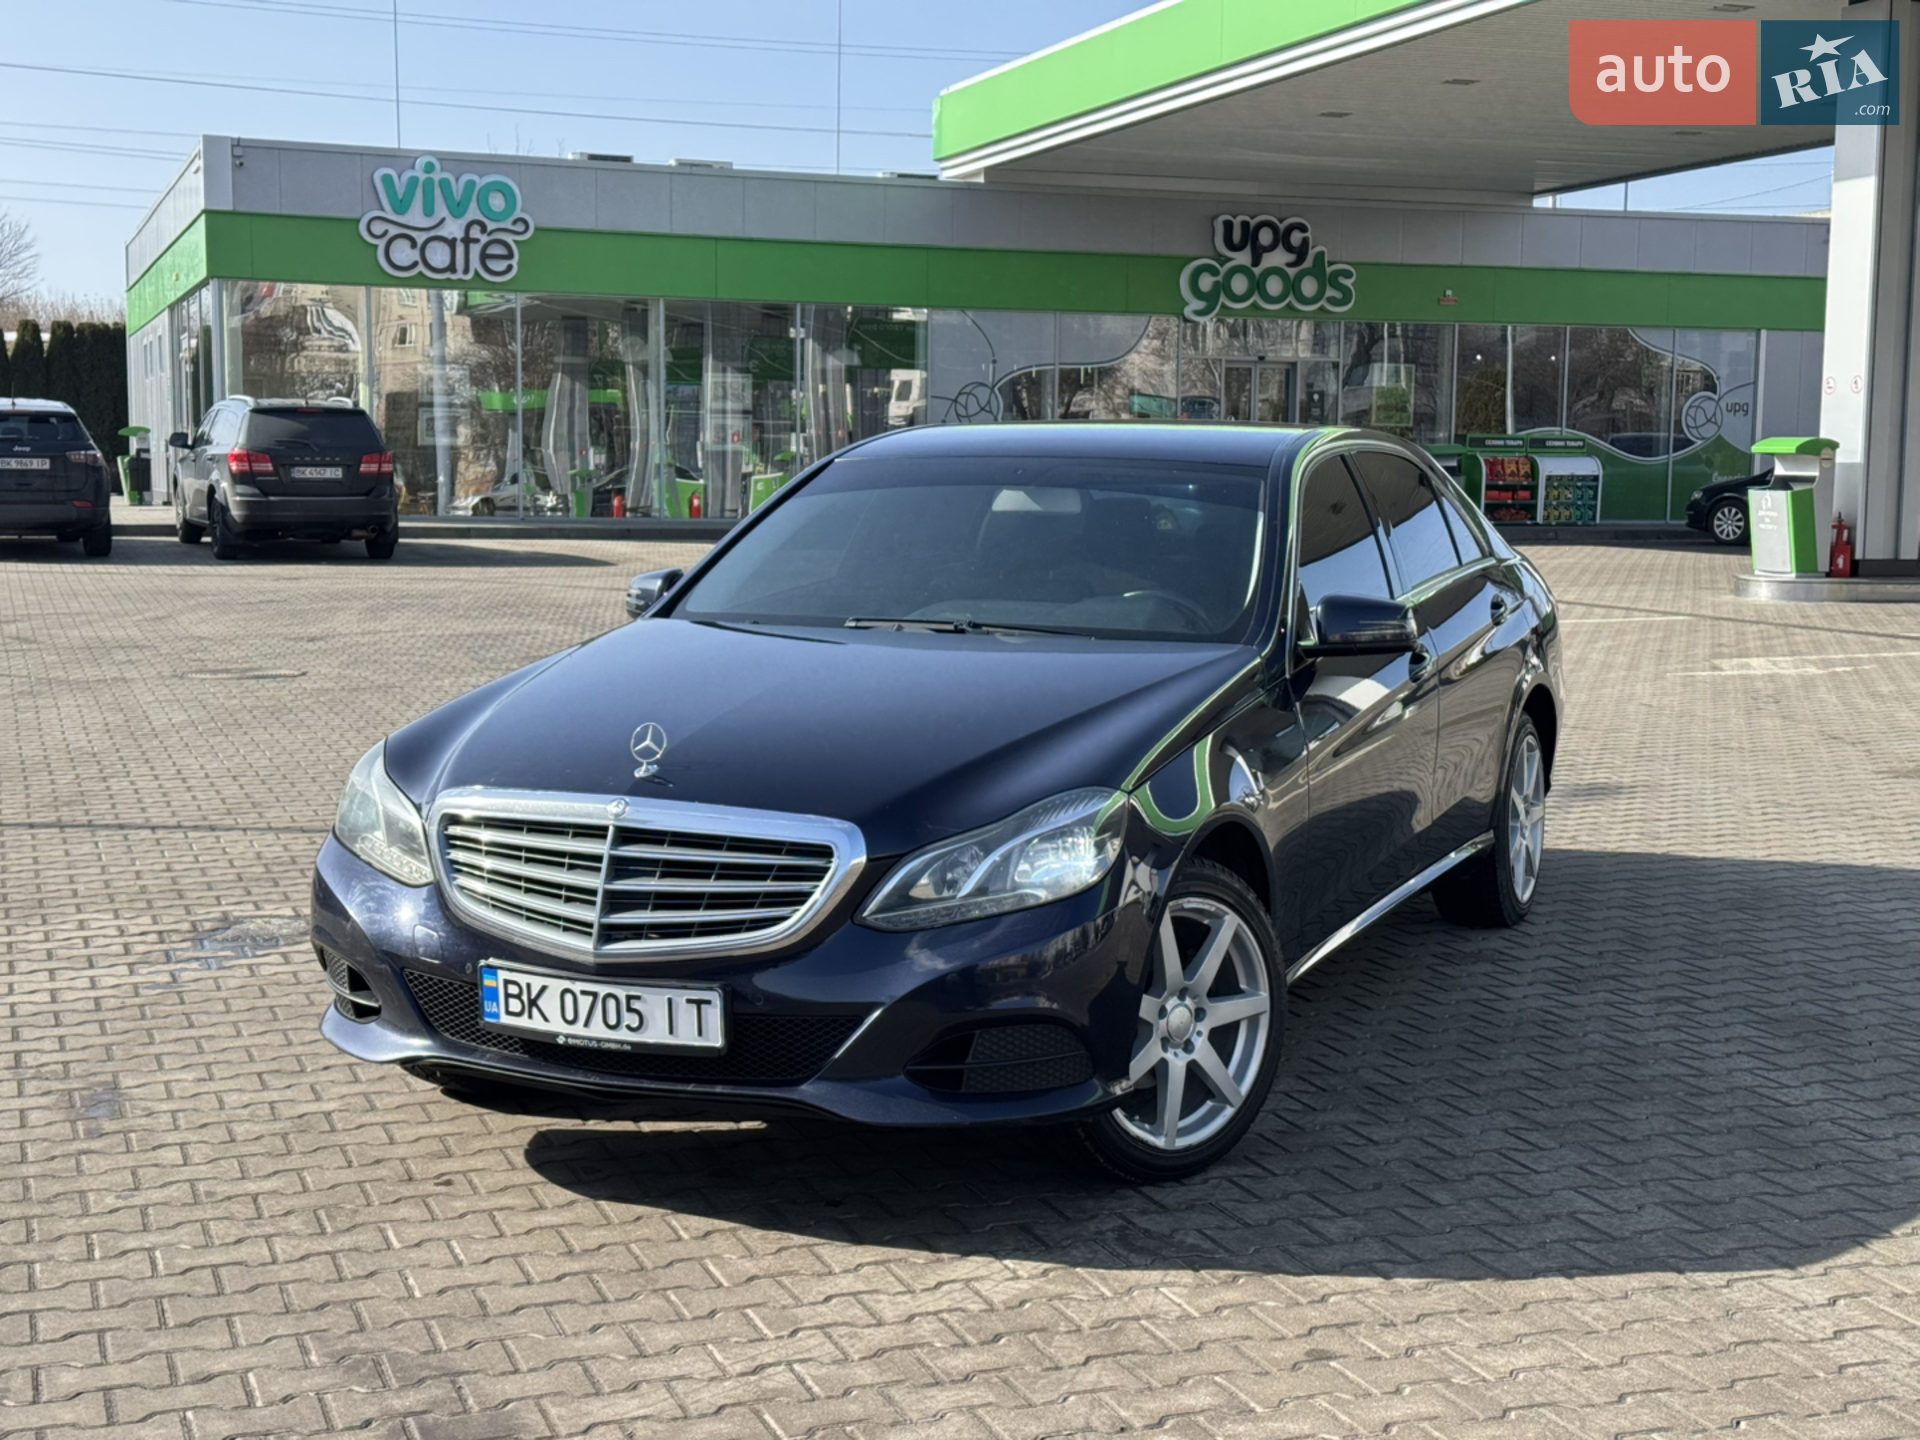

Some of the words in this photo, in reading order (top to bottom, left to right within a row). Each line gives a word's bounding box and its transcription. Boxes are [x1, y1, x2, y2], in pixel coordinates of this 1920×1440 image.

[380, 160, 518, 222] vivo
[1222, 219, 1310, 268] upg
[1189, 249, 1355, 318] goods
[1725, 401, 1749, 417] upg
[484, 1000, 499, 1014] UA
[502, 978, 551, 1023] BK
[559, 987, 645, 1033] 0705
[666, 996, 712, 1037] IT
